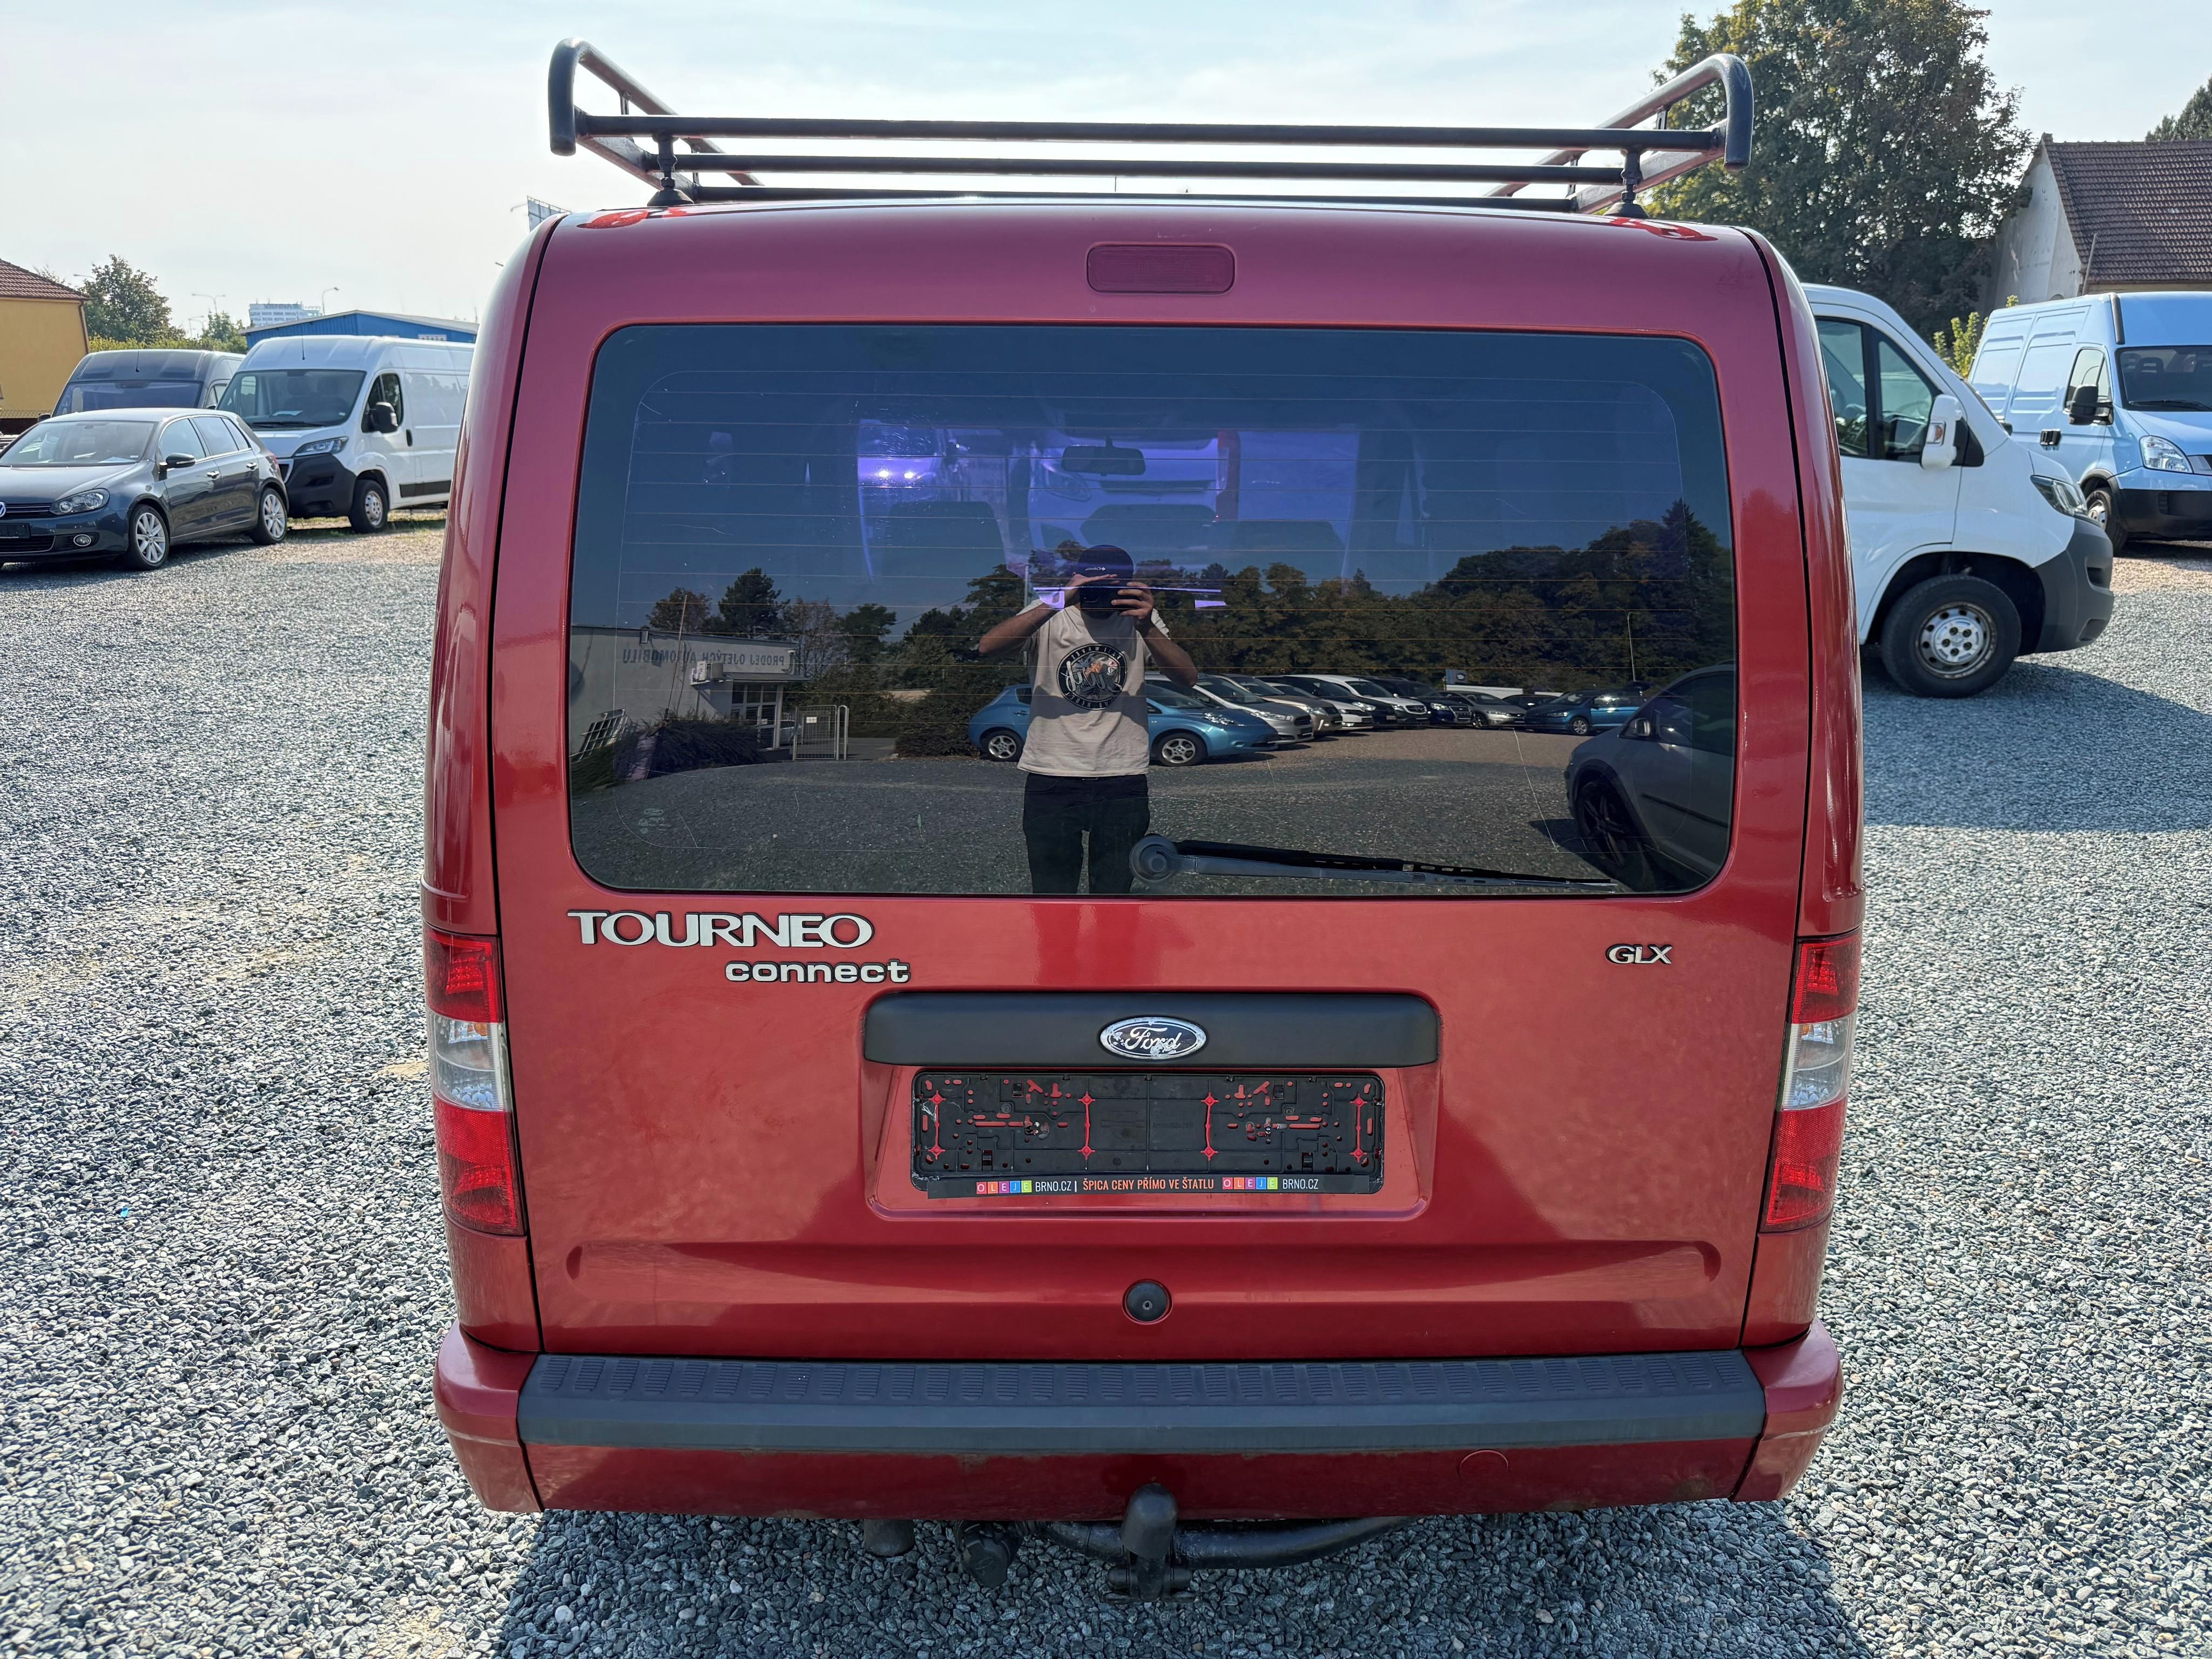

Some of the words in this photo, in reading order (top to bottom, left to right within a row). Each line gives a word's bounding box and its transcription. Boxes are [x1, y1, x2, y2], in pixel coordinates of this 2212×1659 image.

[567, 911, 873, 948] TOURNEO
[1607, 944, 1673, 964] GLX
[725, 960, 911, 982] connect
[1124, 1027, 1182, 1050] Ford
[977, 1182, 1029, 1193] OLEJE
[1035, 1181, 1072, 1192] BRNO.CZ
[1083, 1178, 1109, 1191] ŠPICA
[1111, 1179, 1135, 1191] CENY
[1137, 1177, 1166, 1190] PŘÍMO
[1169, 1179, 1179, 1189] VE
[1182, 1176, 1214, 1189] ŠTATLU
[1223, 1178, 1276, 1189] OLEJE
[1283, 1179, 1319, 1190] BRNO.CZ
